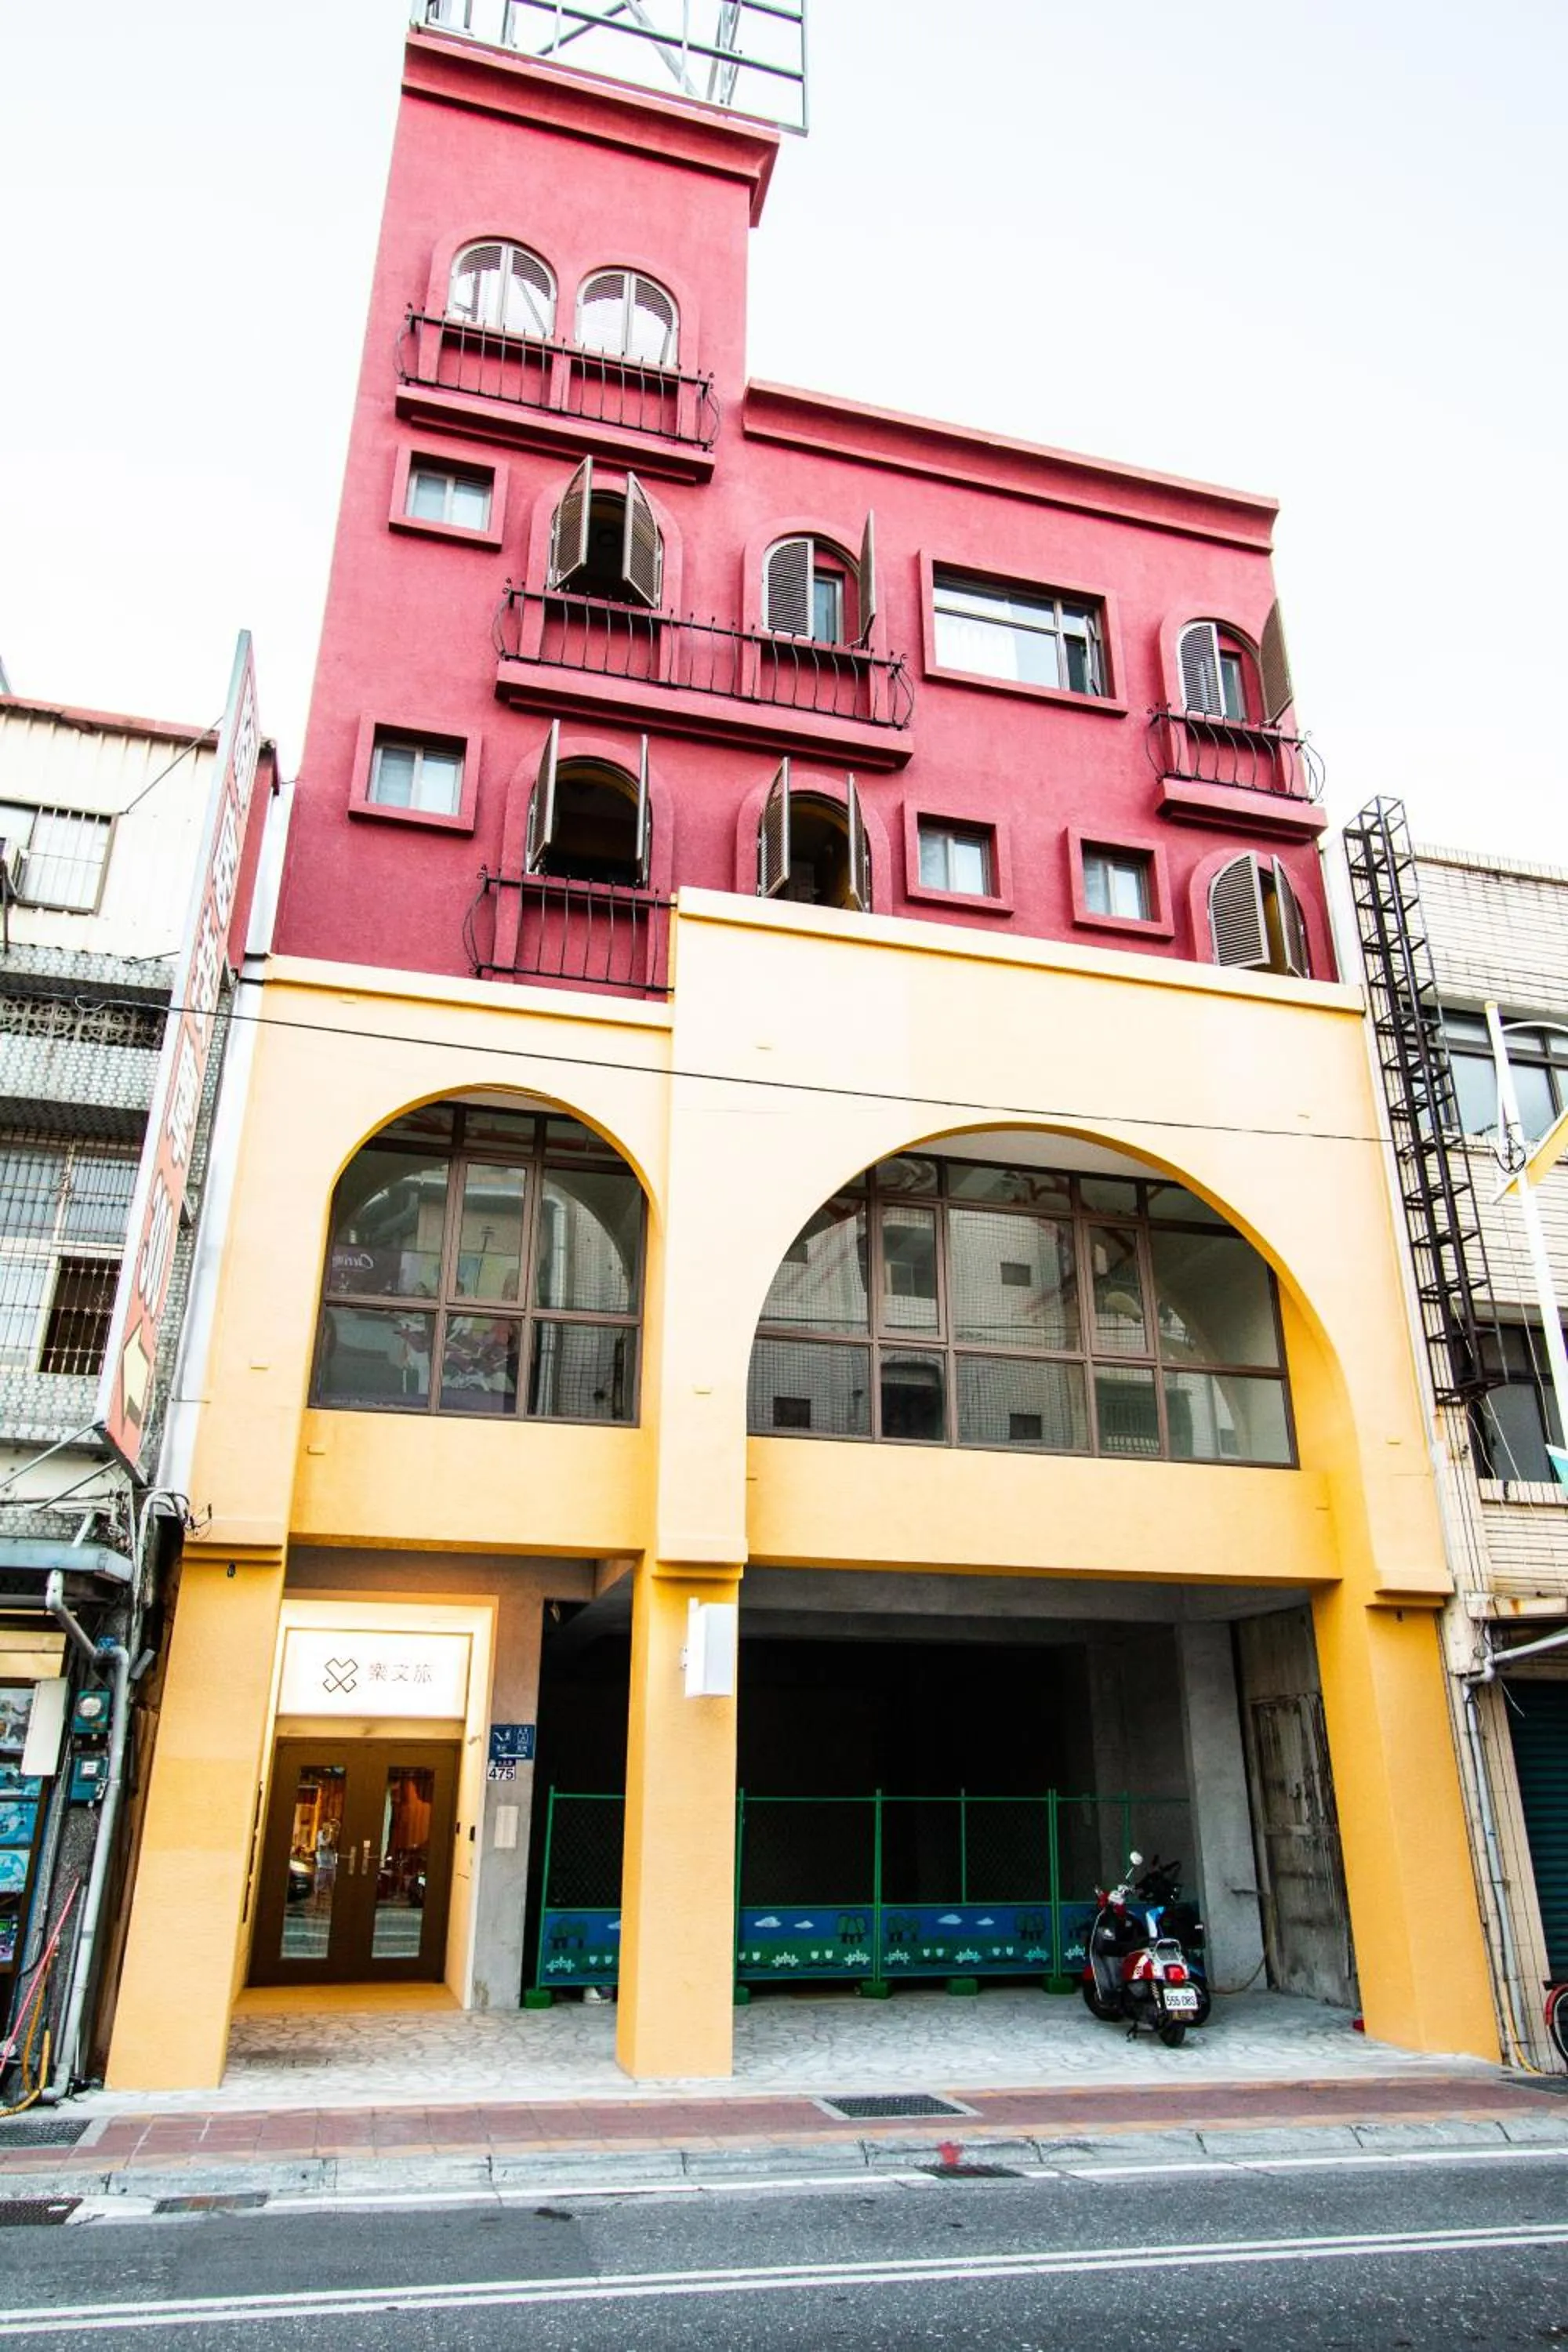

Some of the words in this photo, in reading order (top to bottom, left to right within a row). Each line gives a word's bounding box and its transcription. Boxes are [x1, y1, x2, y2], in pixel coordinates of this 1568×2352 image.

[139, 1172, 173, 1320] 300
[368, 1662, 434, 1683] 樂文旅
[488, 1768, 514, 1780] 475
